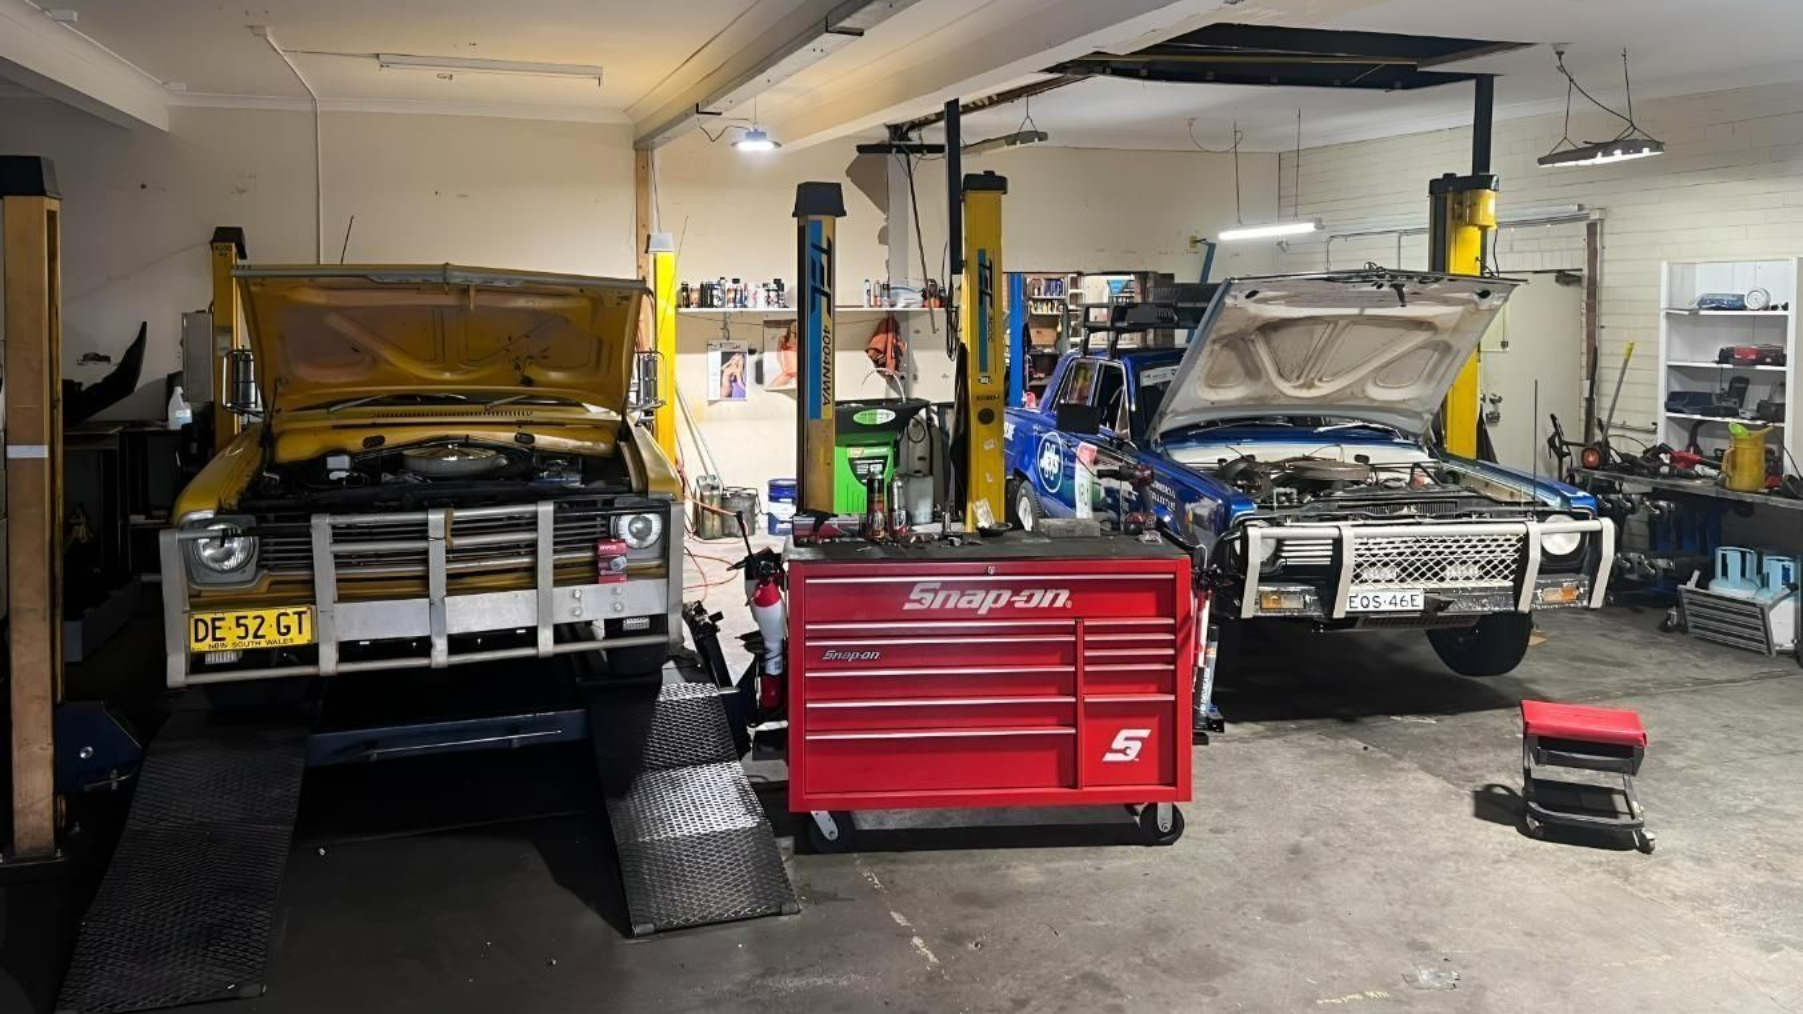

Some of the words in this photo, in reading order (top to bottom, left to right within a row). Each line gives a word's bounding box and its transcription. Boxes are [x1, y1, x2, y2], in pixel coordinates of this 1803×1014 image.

[902, 582, 1071, 615] Snap-on
[232, 640, 261, 649] SOUTH
[265, 637, 295, 646] WALES
[822, 649, 880, 663] Snap-on
